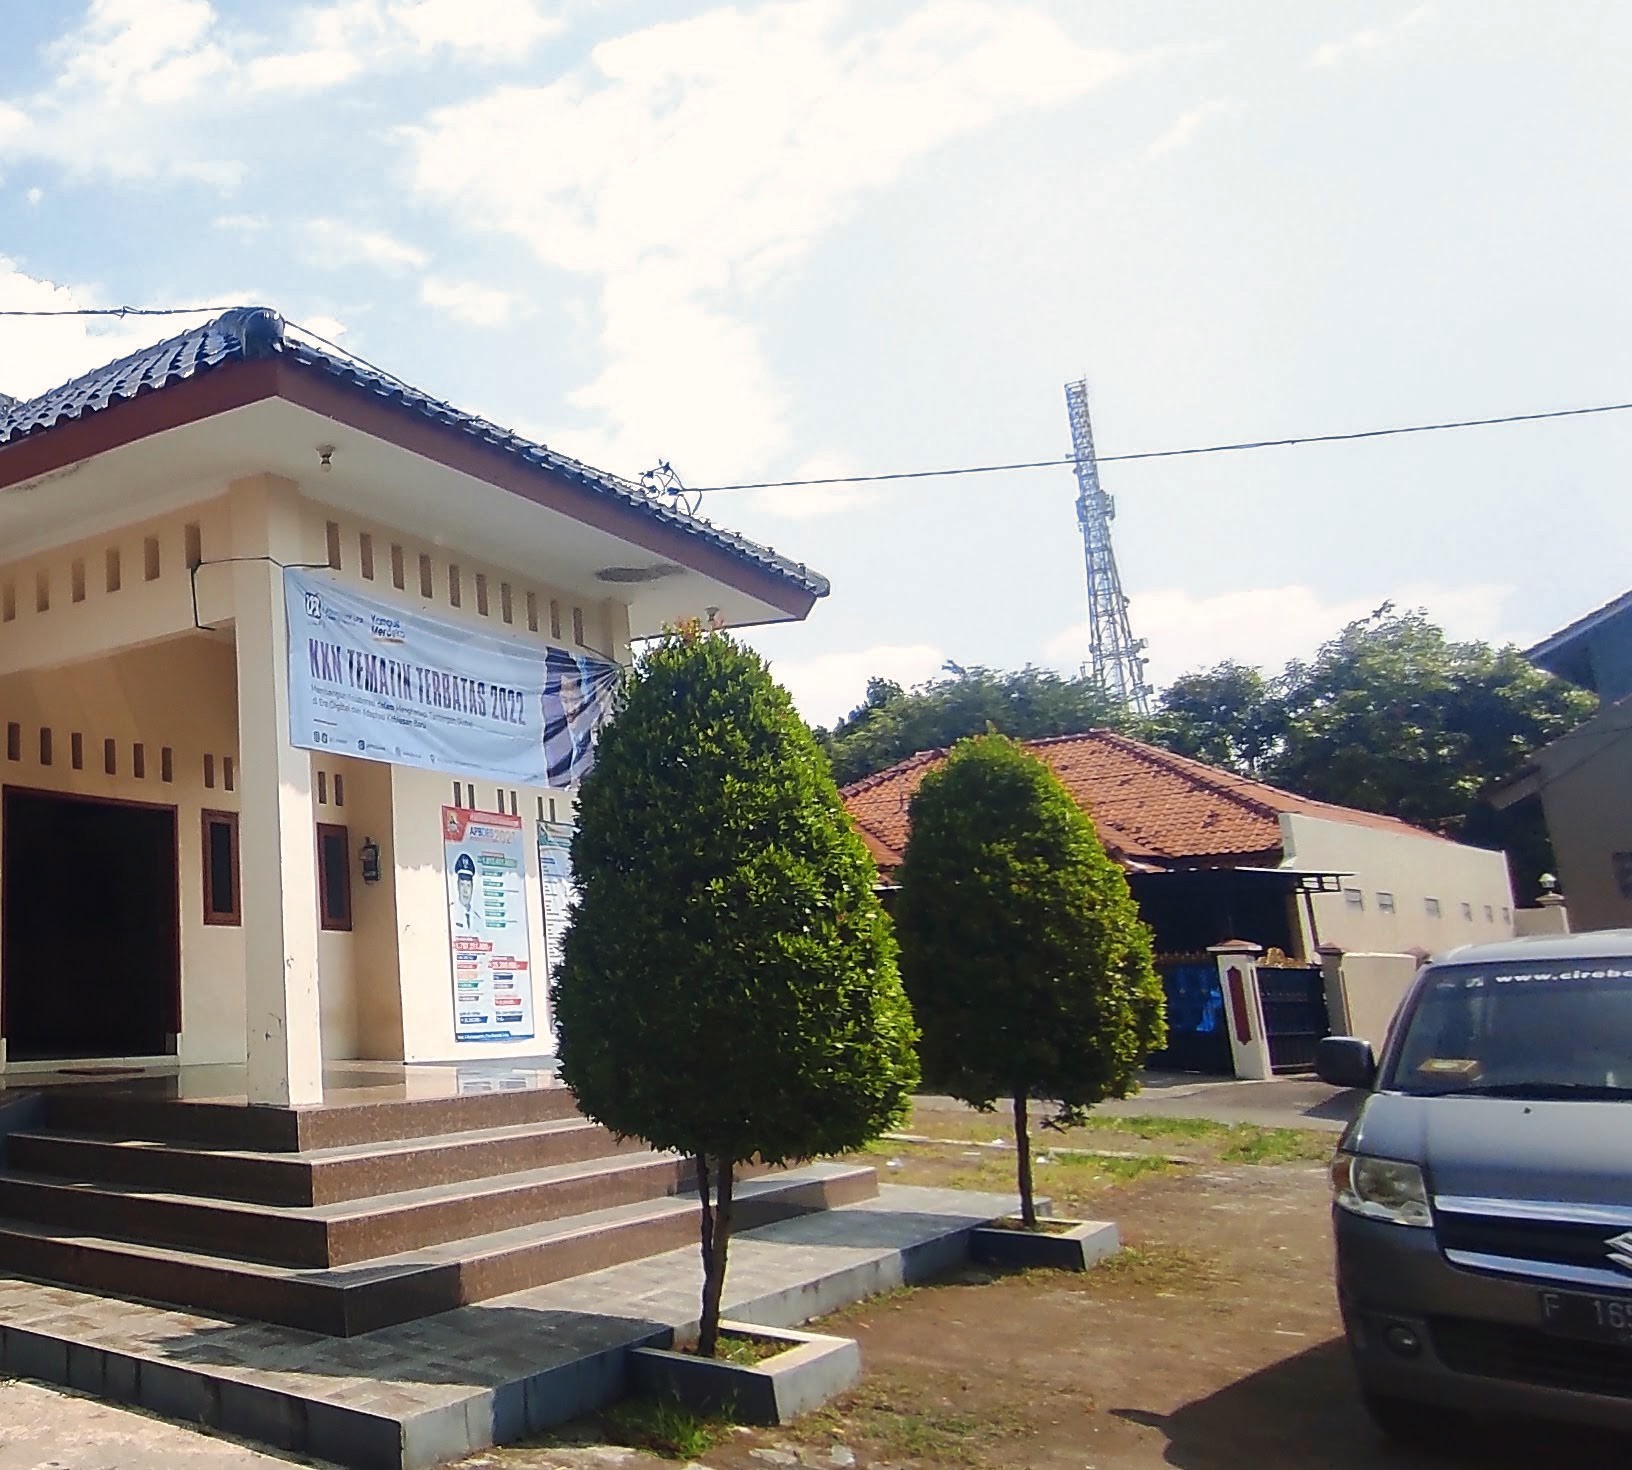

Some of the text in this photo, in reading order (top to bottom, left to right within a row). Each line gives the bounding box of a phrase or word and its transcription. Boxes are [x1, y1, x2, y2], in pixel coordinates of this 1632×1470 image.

[309, 638, 527, 726] KKN TEMATIK TERBATAS 2022
[1543, 1293, 1560, 1318] F
